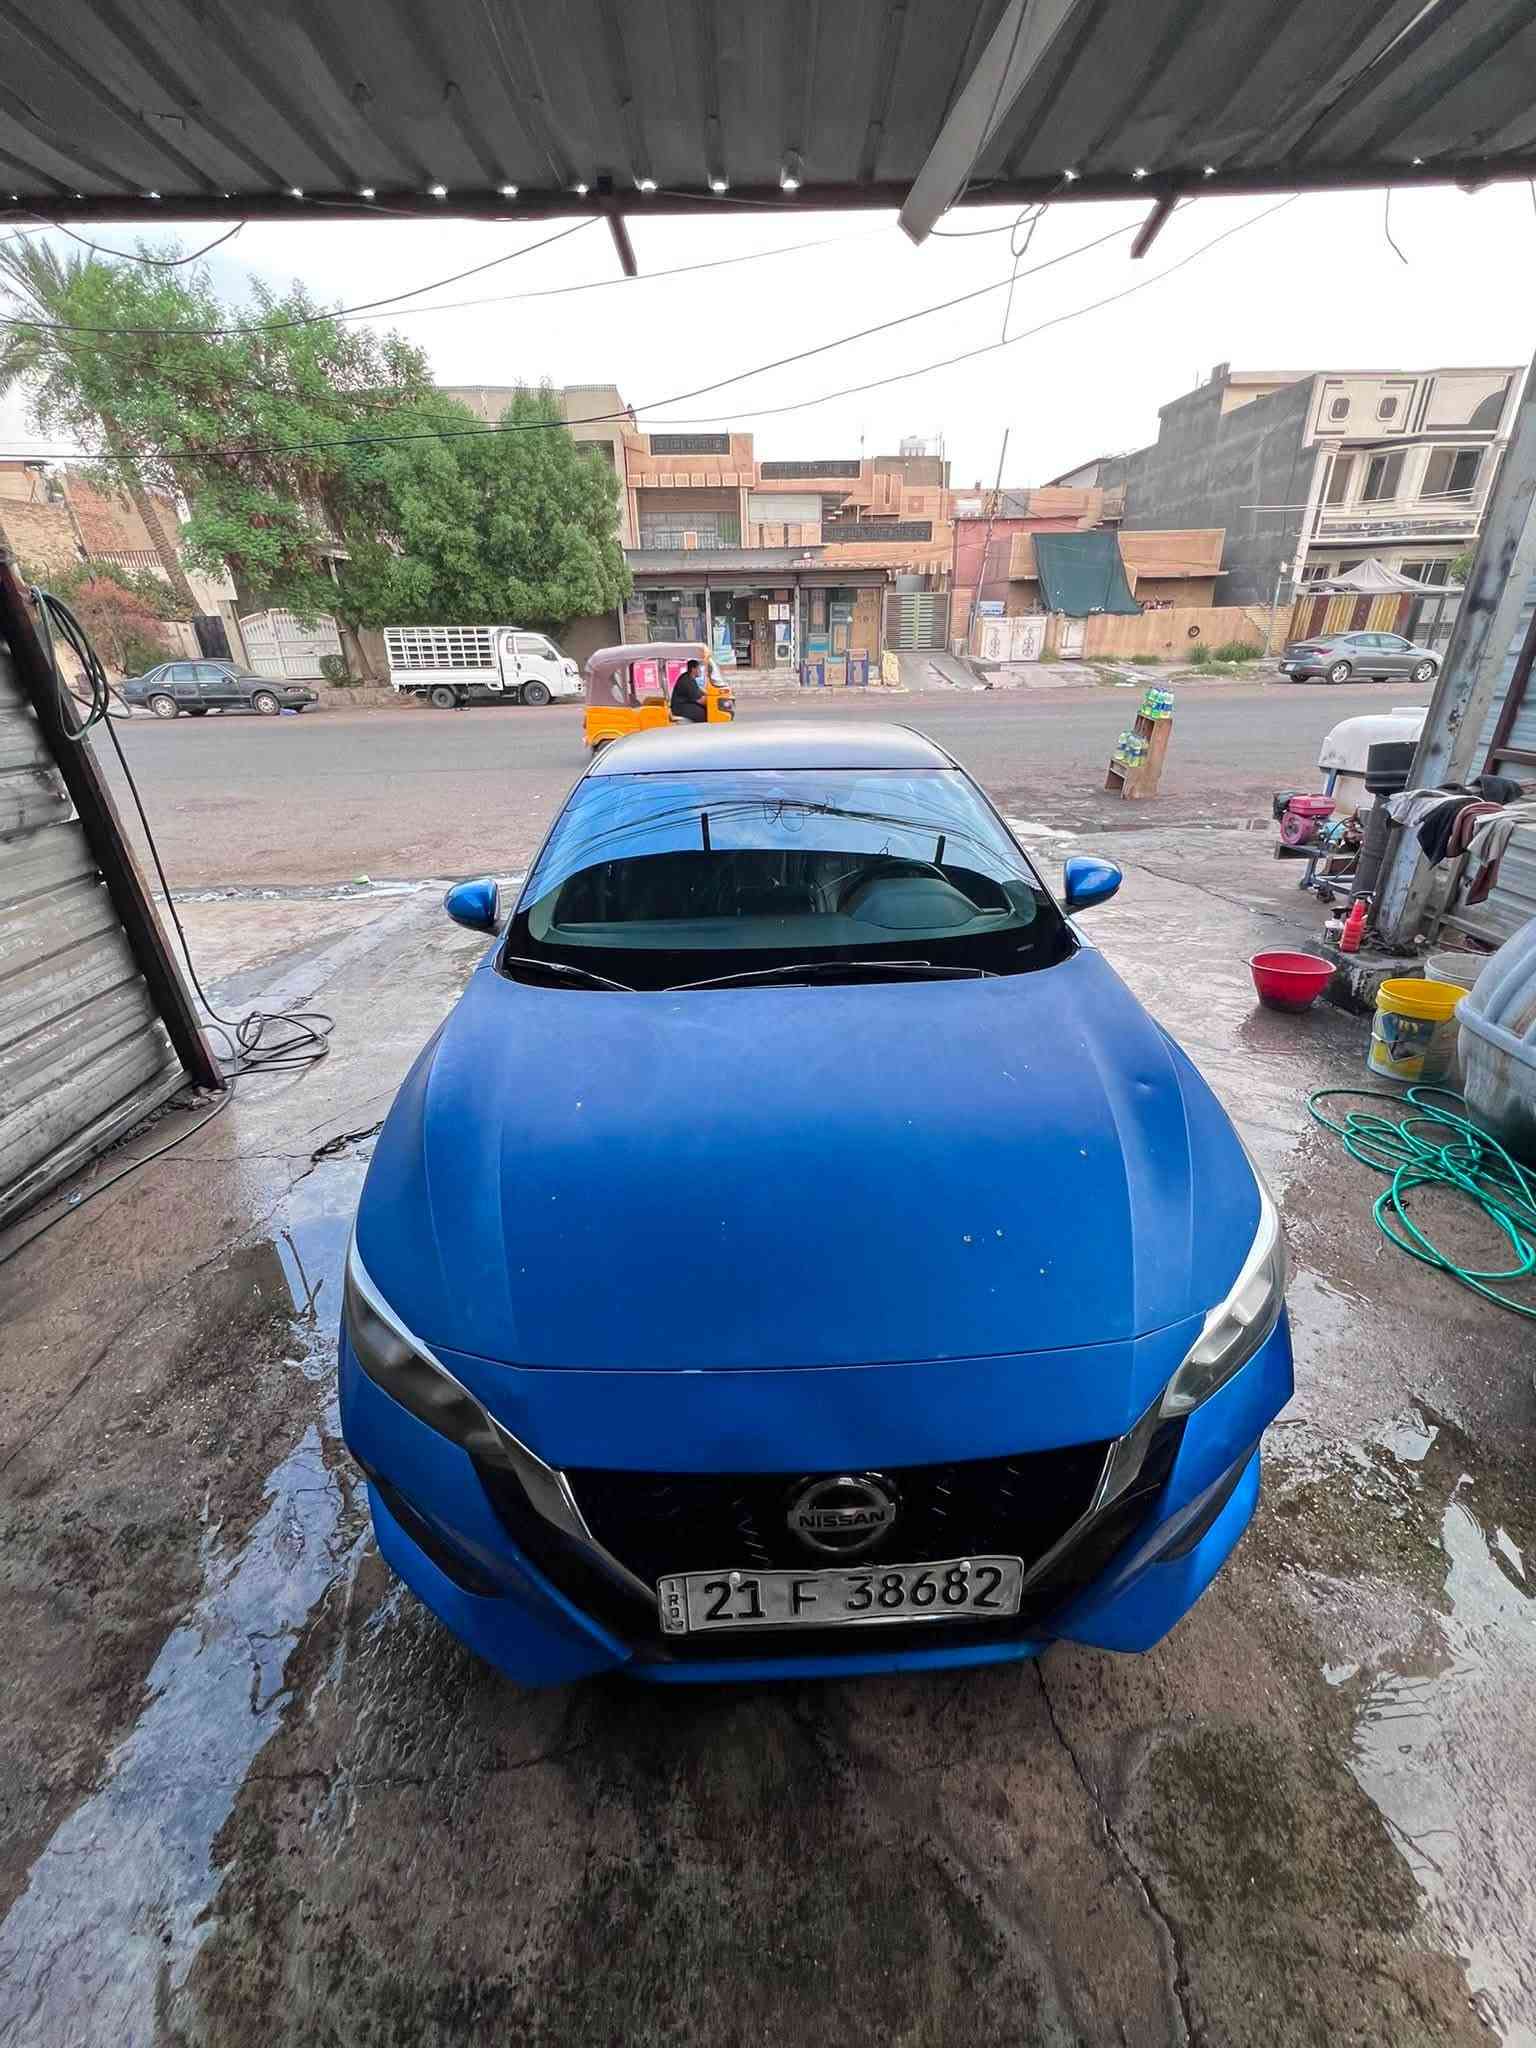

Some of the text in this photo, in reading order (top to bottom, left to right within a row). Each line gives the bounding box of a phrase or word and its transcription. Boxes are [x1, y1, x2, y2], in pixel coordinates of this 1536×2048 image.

[798, 1511, 886, 1528] NISSAN
[703, 1566, 1005, 1621] 21 F 38682
